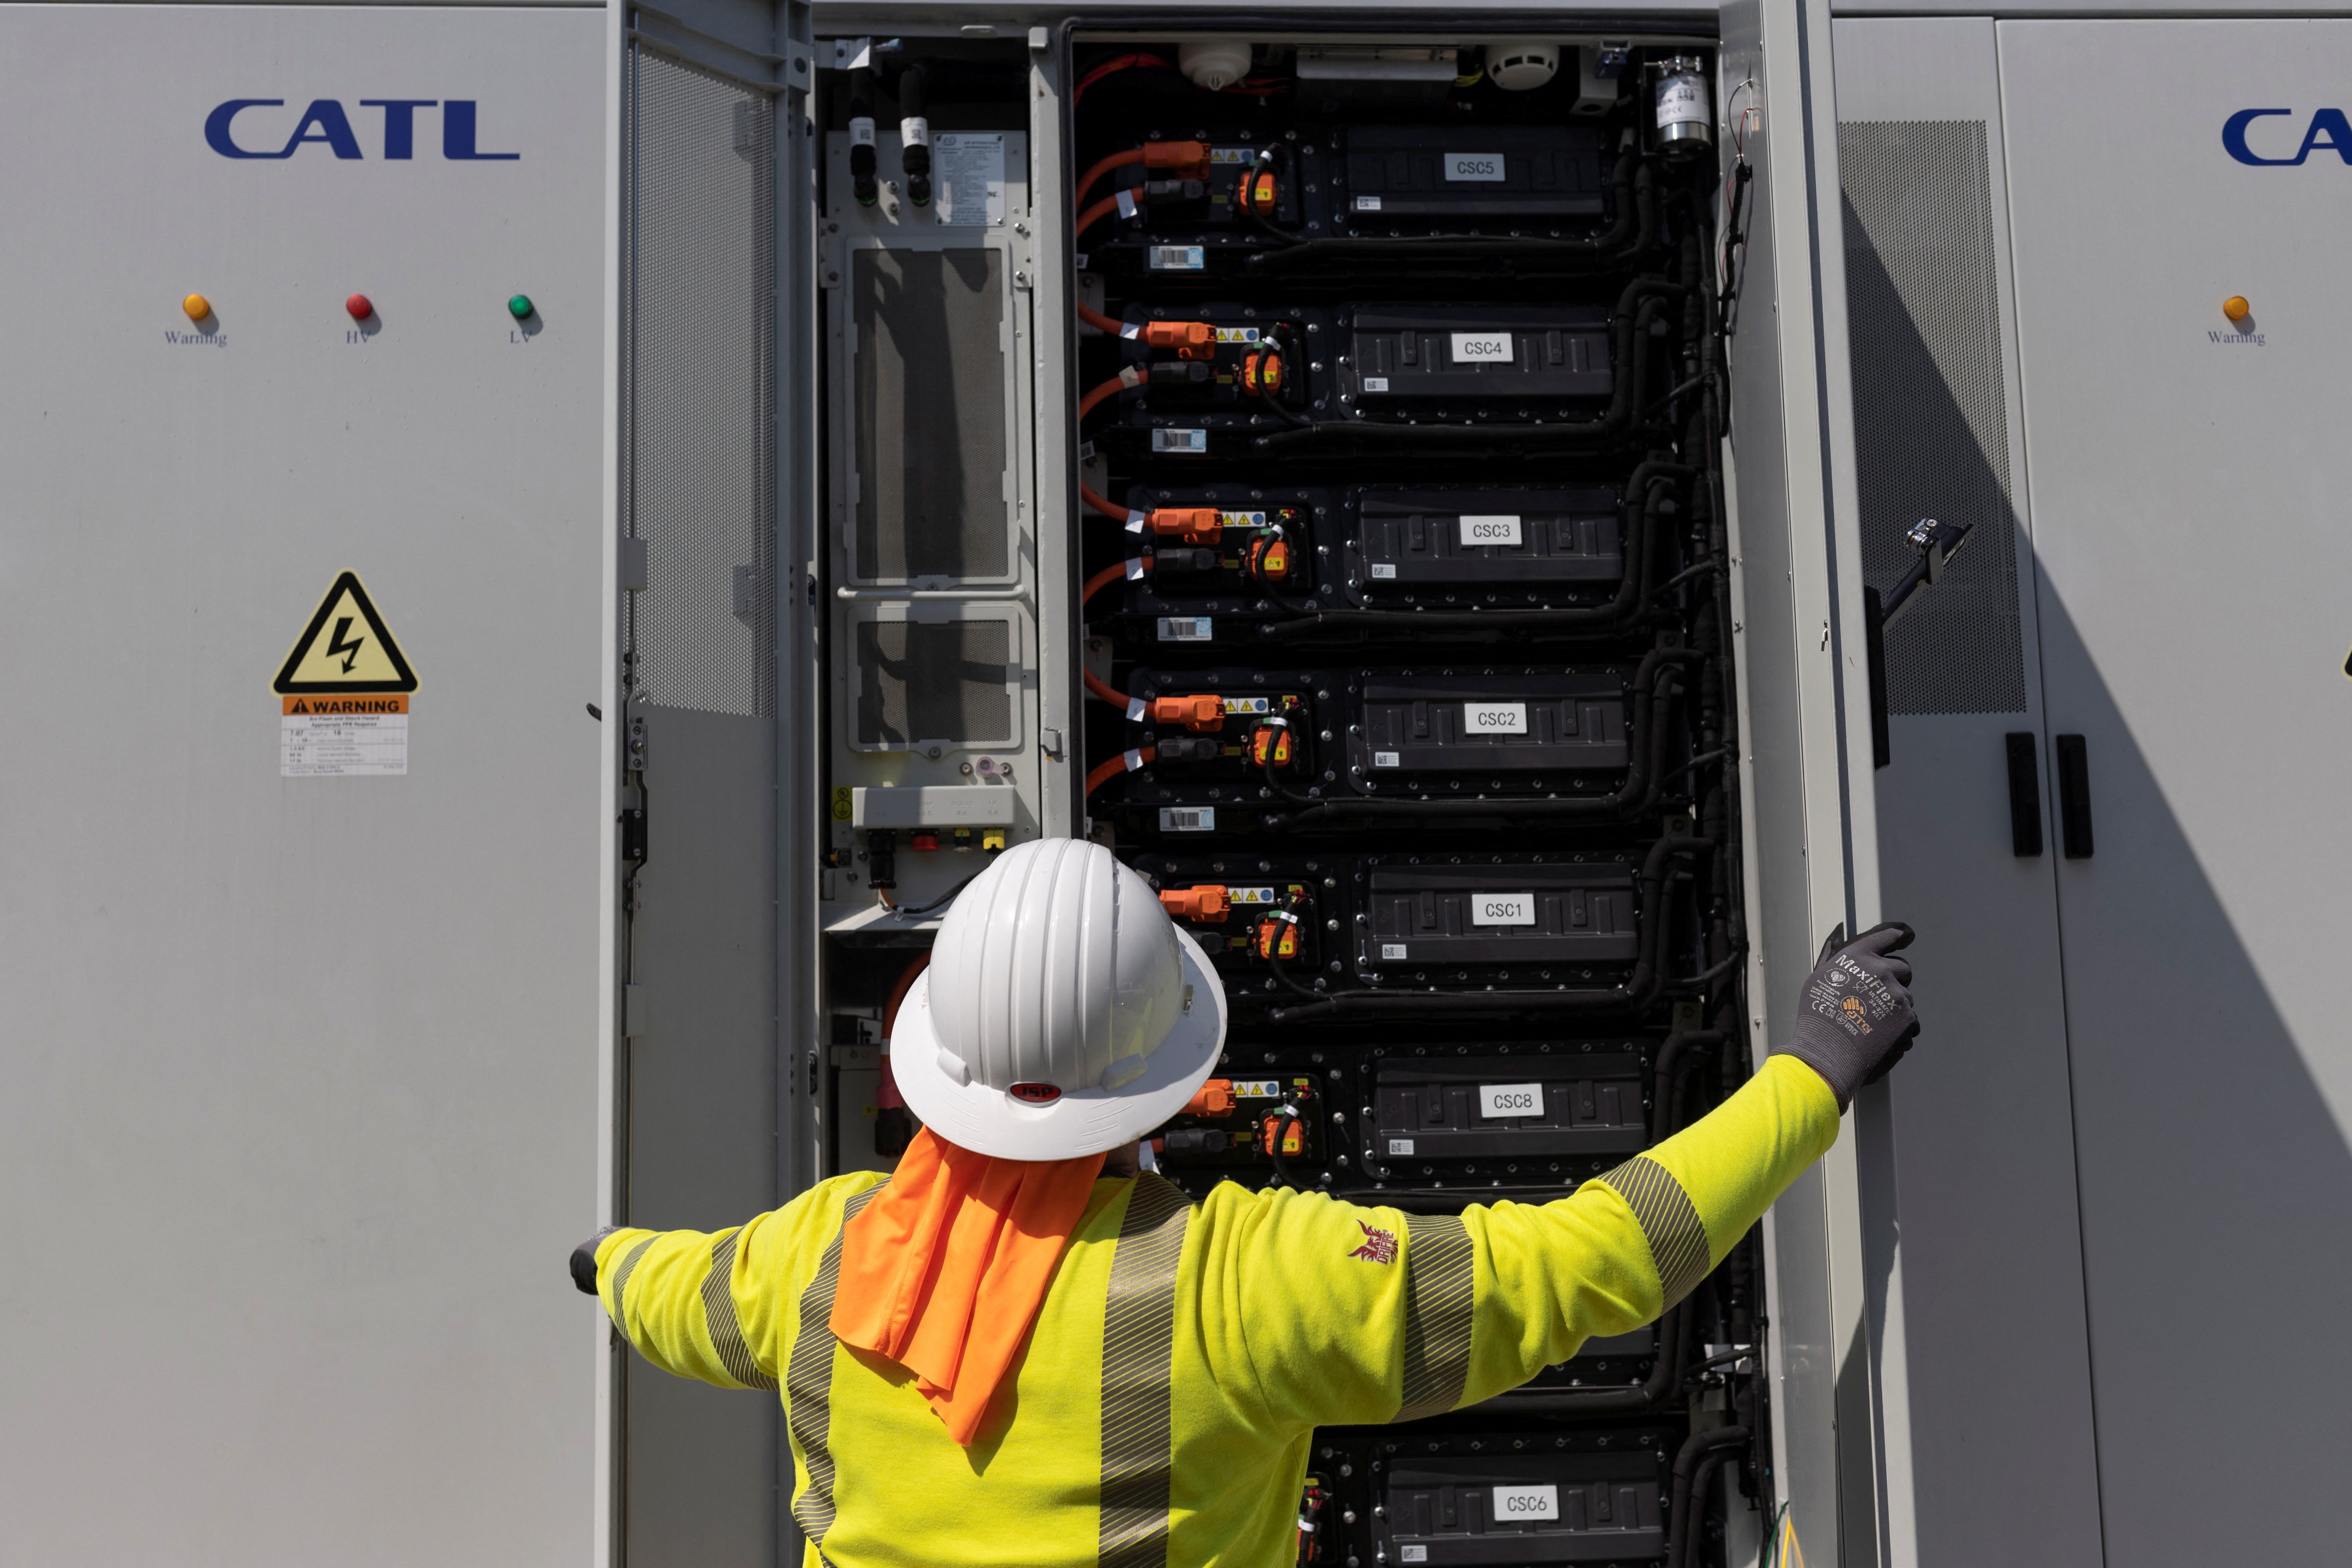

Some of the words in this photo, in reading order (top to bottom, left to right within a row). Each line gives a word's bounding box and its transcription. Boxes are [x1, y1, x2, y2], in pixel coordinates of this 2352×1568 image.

[204, 99, 520, 160] CATL
[1457, 161, 1494, 175] CSC5
[164, 330, 228, 349] Warning
[346, 330, 371, 345] HV
[509, 330, 533, 345] LV
[2207, 330, 2266, 346] Warning
[1465, 342, 1502, 355] CSC4
[1473, 524, 1511, 538] CSC3
[313, 700, 400, 713] WARNING
[1478, 712, 1516, 726] CSC2
[1485, 903, 1521, 917] CSC1
[1835, 954, 1897, 1011] MaxiFlex
[1868, 999, 1886, 1018] 34-874
[1018, 1086, 1054, 1098] JSP
[1494, 1094, 1532, 1109] CSC8
[1377, 1232, 1394, 1265] DRIFIRE
[1507, 1496, 1547, 1512] CSC6
